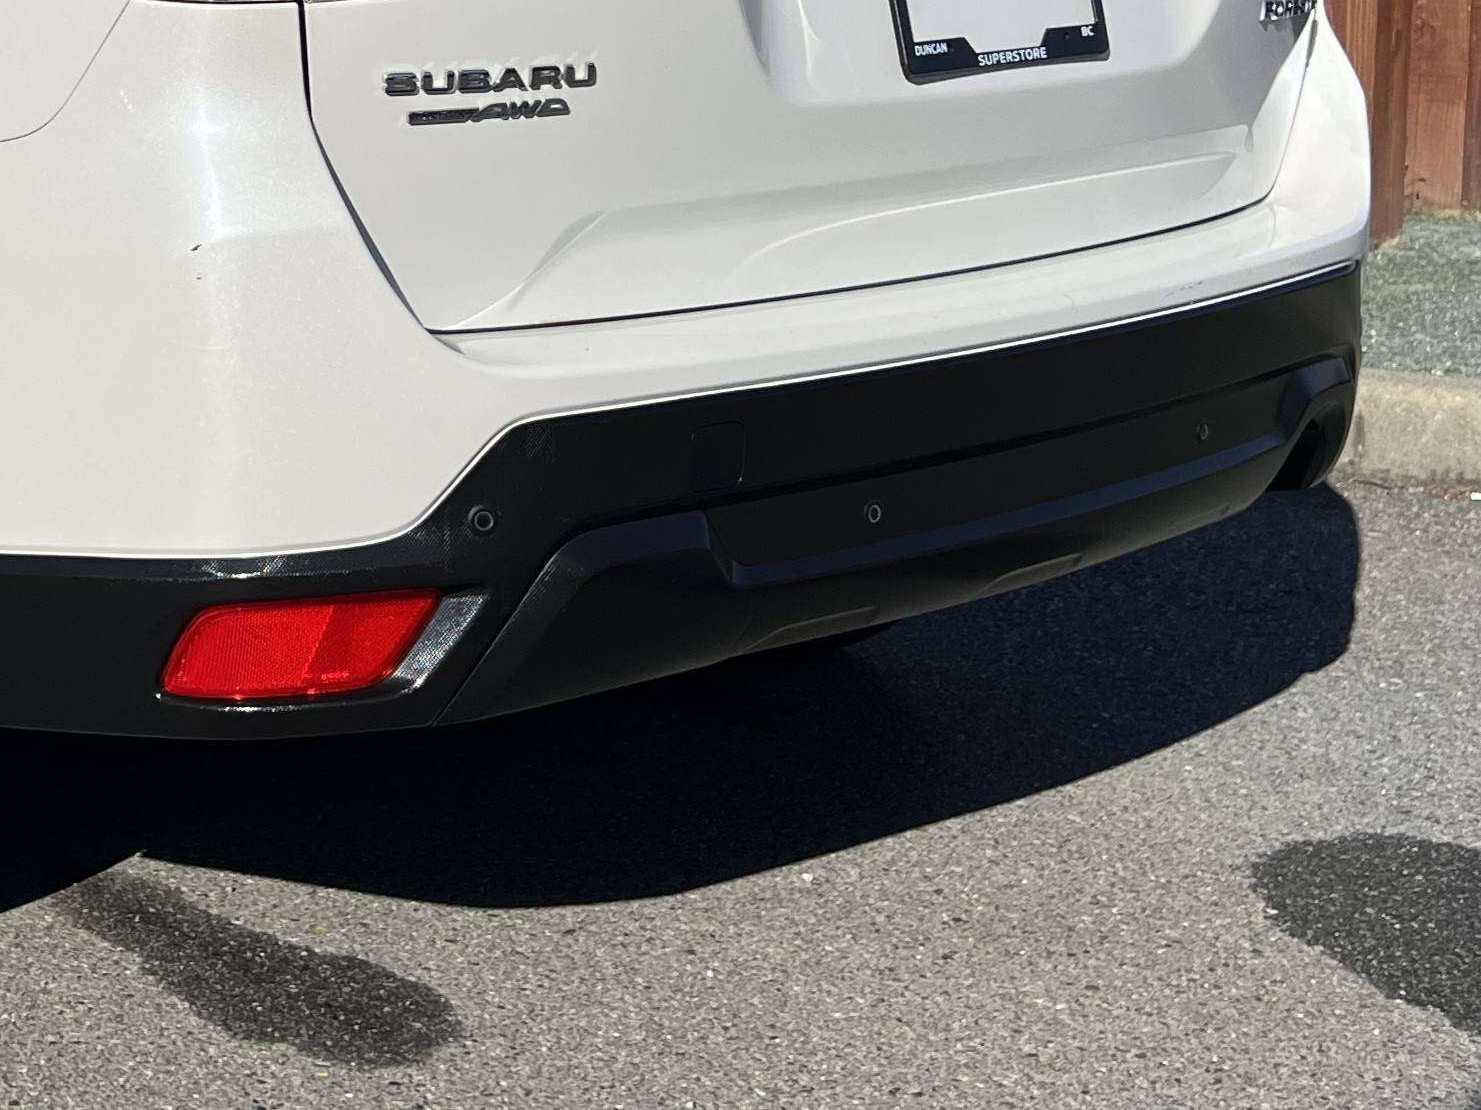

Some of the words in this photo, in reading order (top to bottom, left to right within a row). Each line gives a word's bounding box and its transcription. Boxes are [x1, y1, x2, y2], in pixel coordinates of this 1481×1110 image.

[1081, 26, 1094, 37] BC
[915, 43, 948, 56] DUNCAN
[978, 47, 1047, 66] SUPERSTORE
[384, 62, 597, 96] SUBARU
[470, 98, 570, 123] AWD
